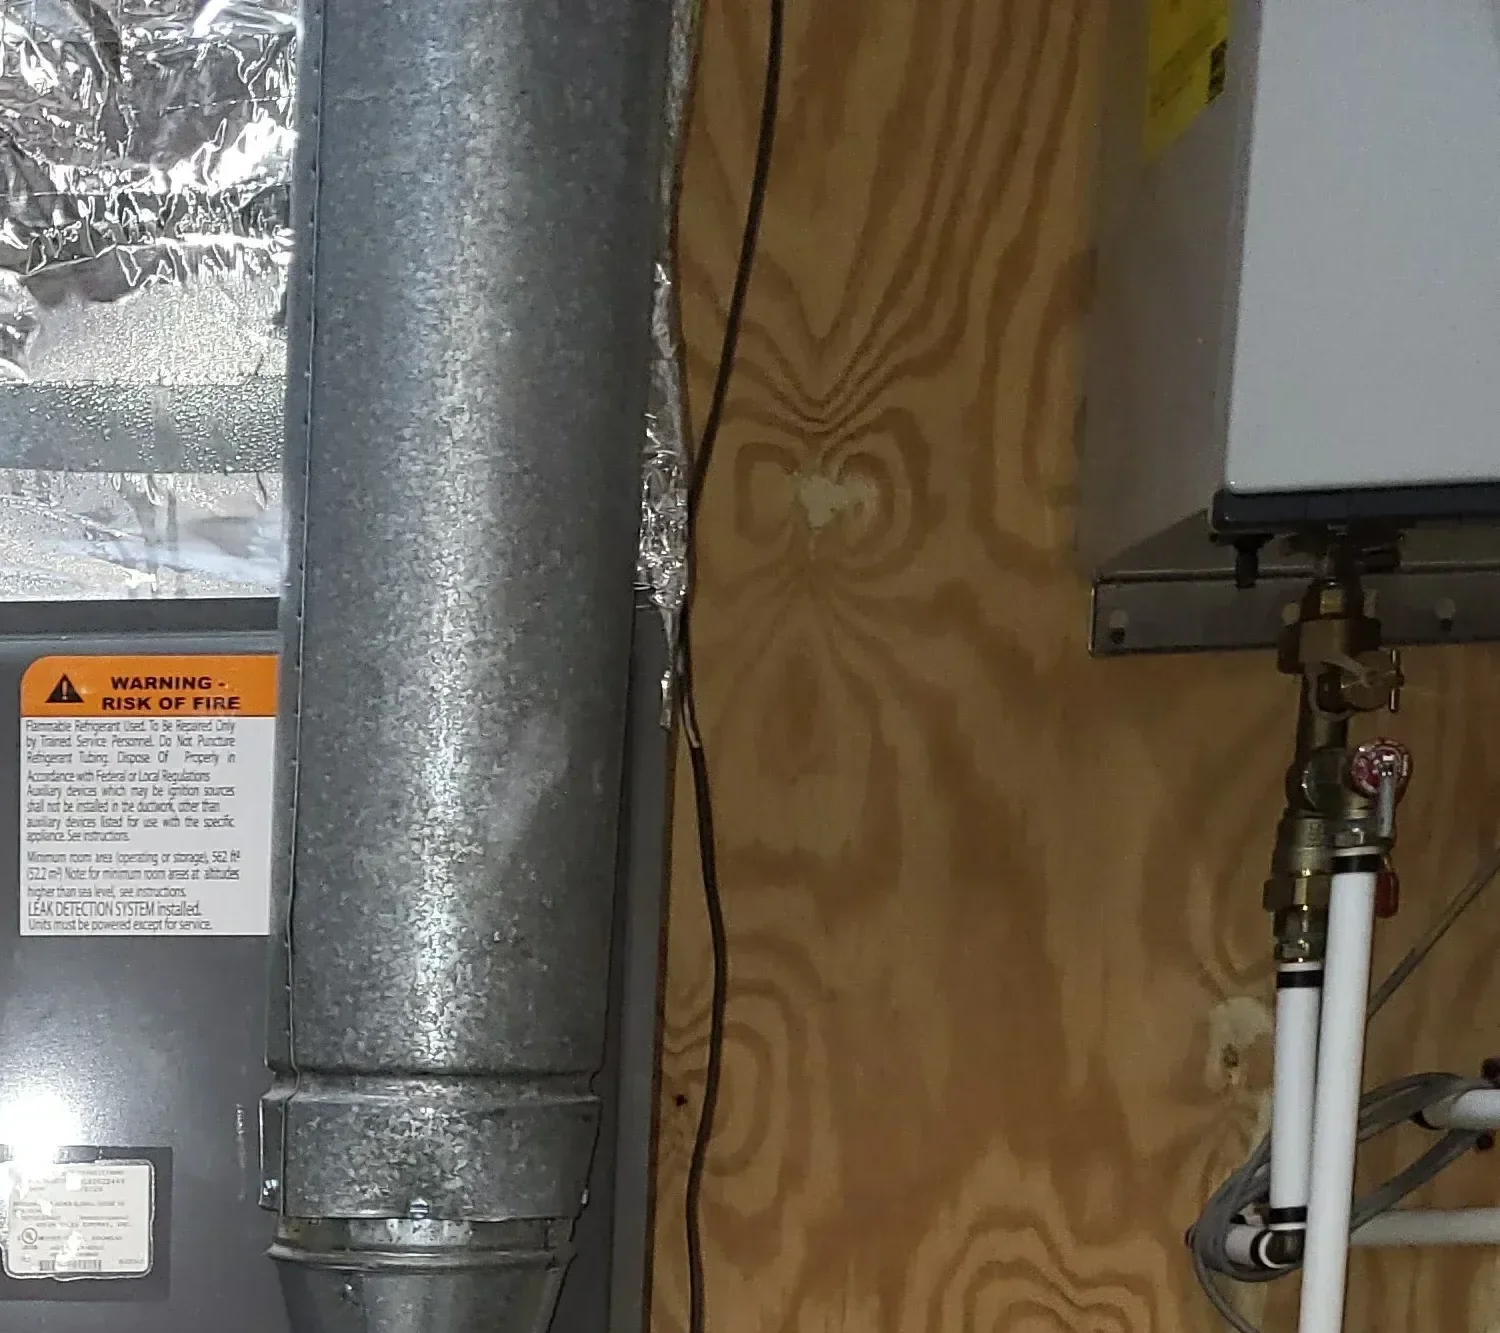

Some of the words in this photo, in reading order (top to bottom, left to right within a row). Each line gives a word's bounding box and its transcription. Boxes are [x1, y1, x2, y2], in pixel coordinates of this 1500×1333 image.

[111, 676, 212, 690] WARNING
[102, 697, 152, 710] RISK
[159, 696, 186, 710] OF
[193, 696, 241, 710] FIRE
[28, 902, 53, 916] LEAK
[56, 901, 113, 916] DETECTION
[116, 901, 154, 916] SYSTEM
[157, 901, 202, 916] installed.
